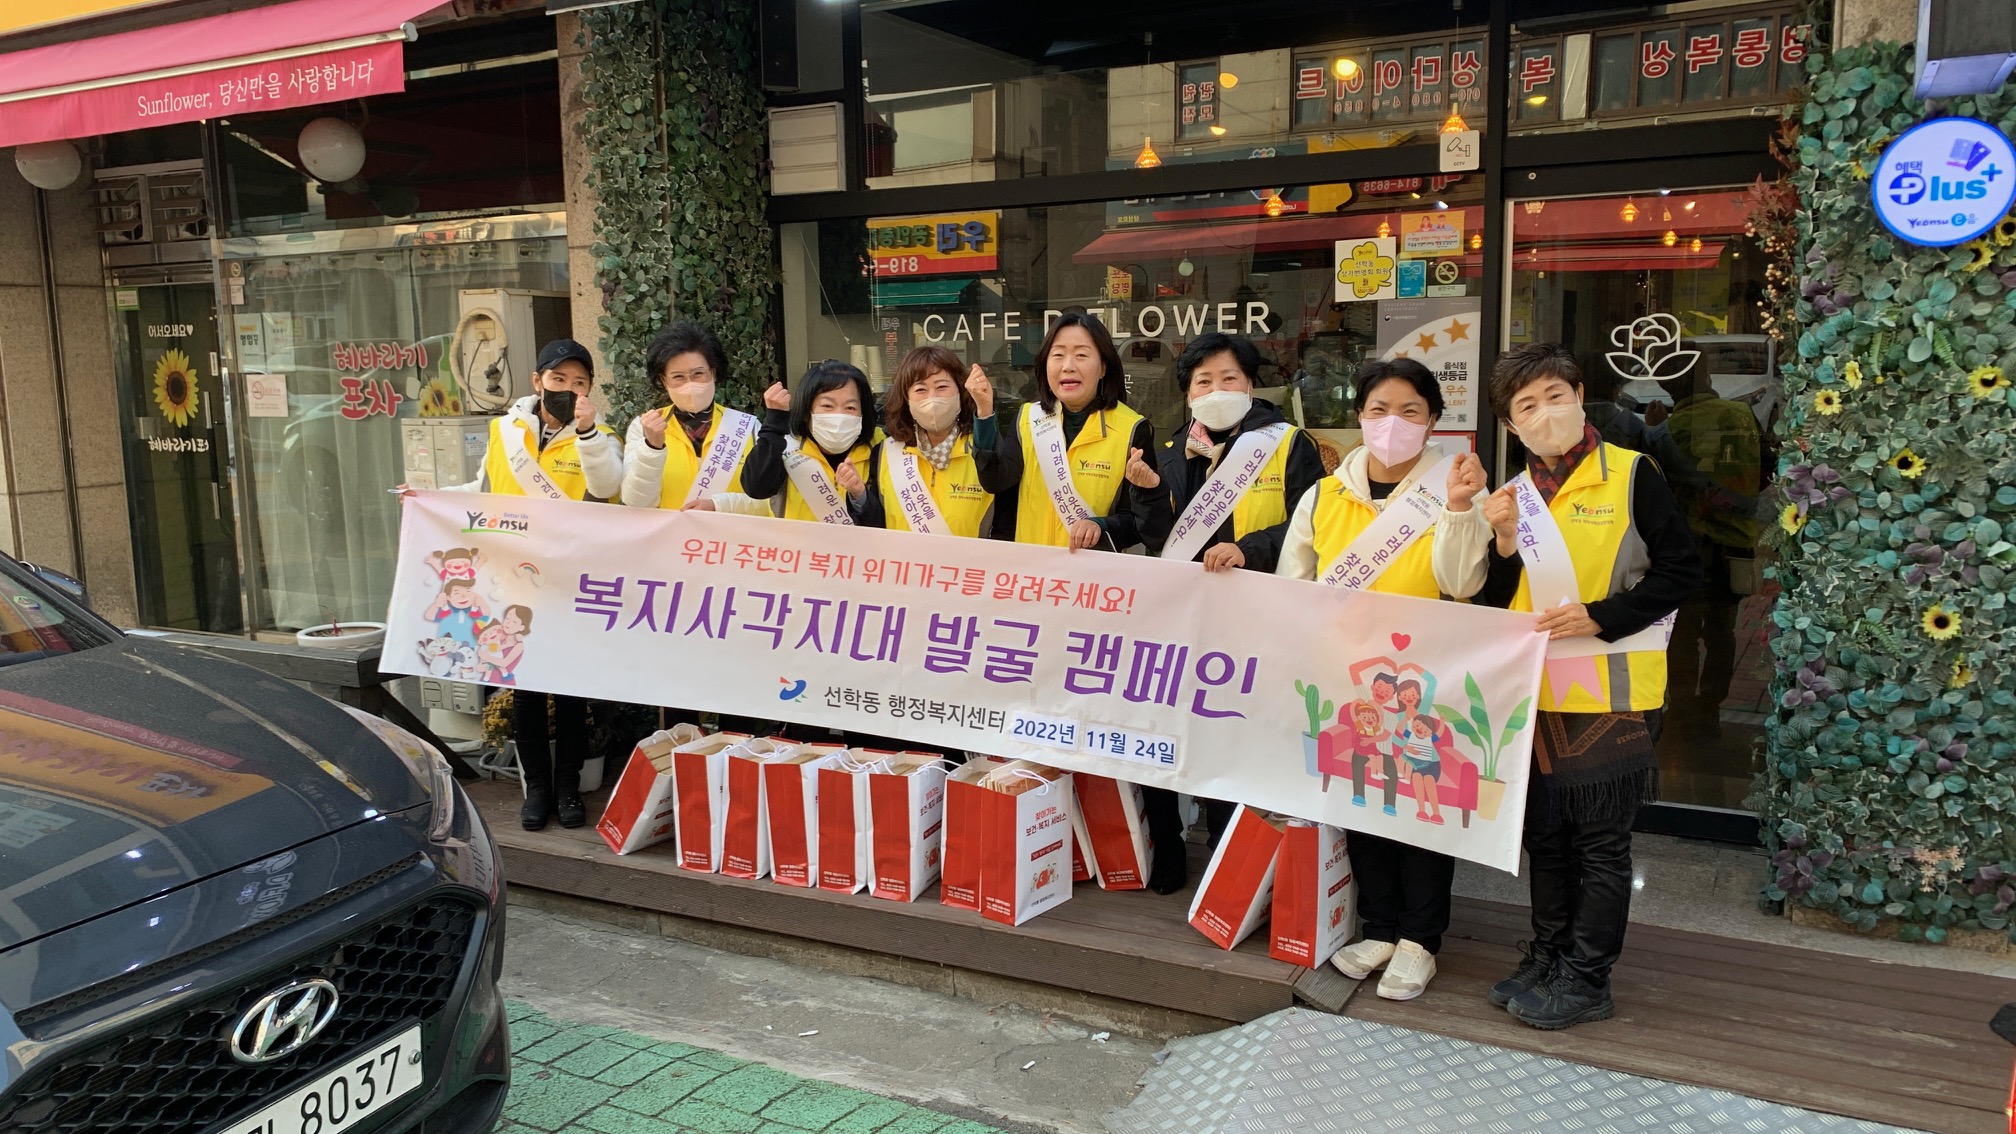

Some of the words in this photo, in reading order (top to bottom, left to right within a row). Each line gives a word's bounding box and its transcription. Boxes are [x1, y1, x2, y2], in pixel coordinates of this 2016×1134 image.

[138, 91, 213, 118] Sunflower,
[219, 72, 282, 107] 당신만을
[287, 58, 374, 95] 사랑합니다
[1895, 160, 1923, 174] 혜택
[1907, 217, 1949, 229] Yeonsu
[148, 323, 187, 338] 어서오세요
[922, 310, 1023, 343] CAFE
[1443, 361, 1467, 370] 음식점
[339, 377, 404, 420] 포차
[736, 413, 752, 439] 어려운
[696, 433, 731, 500] 찾아주세요!
[721, 440, 742, 473] 이웃을
[1050, 440, 1067, 482] 어려운
[1079, 459, 1111, 471] Yeonsu
[1233, 448, 1267, 489] 어려운
[810, 470, 839, 507] 어려운
[910, 480, 936, 521] 이웃을
[949, 482, 983, 493] Yeonsu
[1418, 483, 1444, 508] Yeonsu
[466, 510, 529, 532] Yeonsu
[1170, 479, 1226, 548] 찾아주세요!
[1202, 488, 1238, 529] 이웃을
[1572, 502, 1615, 516] Yeonsu
[1371, 524, 1416, 566] 어려운
[680, 538, 727, 566] 우리
[733, 543, 801, 575] 주변의
[808, 550, 855, 580] 복지
[862, 557, 987, 597] 위기가구를
[992, 572, 1137, 615] 알려주세요!
[574, 572, 907, 664] 복지사각지대
[923, 612, 1041, 684] 발굴
[1064, 629, 1259, 720] 캠페인
[823, 685, 881, 715] 선학동
[888, 693, 1006, 734] 행정복지센터
[1013, 717, 1076, 746] 2022년
[1086, 729, 1127, 755] 11월
[1134, 738, 1176, 766] 24일
[1034, 805, 1057, 822] 찾아가는
[1050, 811, 1067, 827] 서비스
[300, 1043, 401, 1134] 8037
